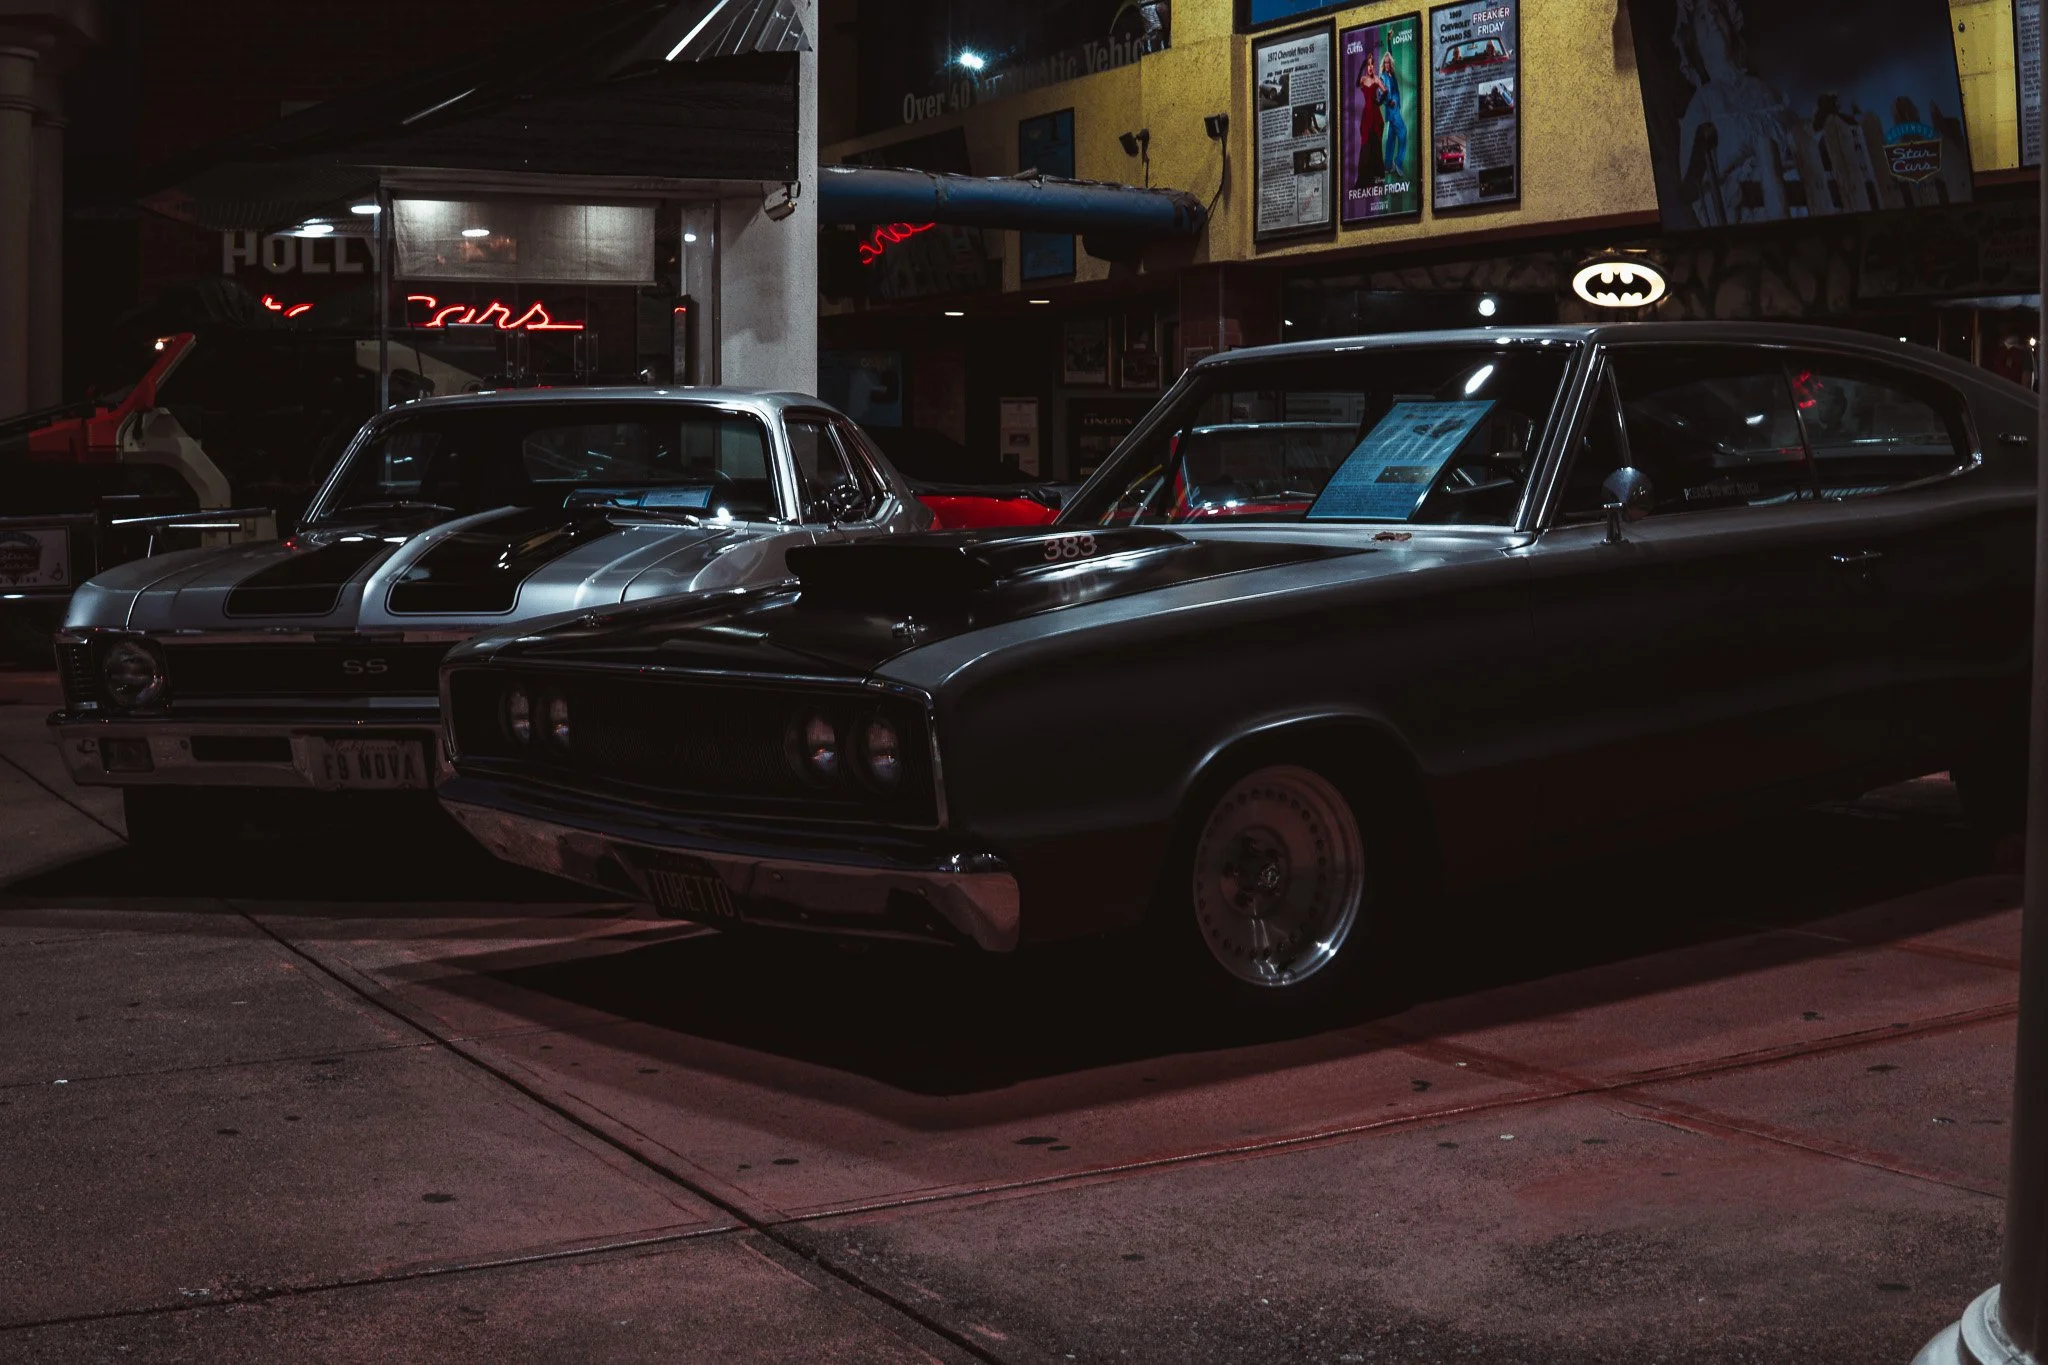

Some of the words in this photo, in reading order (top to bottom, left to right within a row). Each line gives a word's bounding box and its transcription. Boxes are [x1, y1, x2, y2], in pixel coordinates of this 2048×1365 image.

[1472, 7, 1510, 25] FREAKIER
[1477, 21, 1505, 36] FRIDAY
[903, 92, 945, 124] Over
[951, 80, 971, 112] 40
[1891, 148, 1937, 161] Star
[1892, 160, 1938, 174] Cars
[1348, 186, 1383, 200] FREAKIER
[1384, 181, 1411, 196] FRIDAY
[1083, 416, 1133, 426] LINCOLN
[1044, 534, 1097, 560] 383
[342, 659, 388, 674] SS
[358, 753, 416, 780] NOVA
[648, 868, 734, 918] TORETTO
